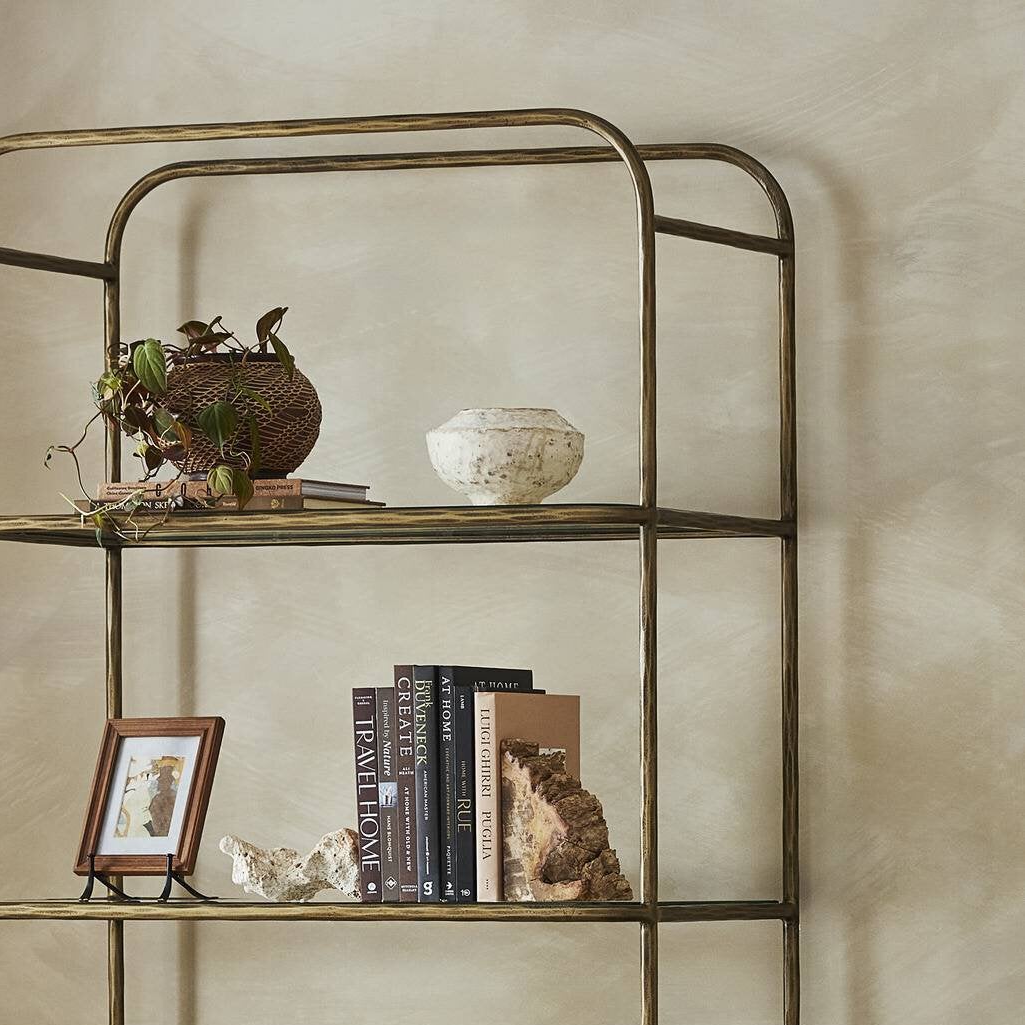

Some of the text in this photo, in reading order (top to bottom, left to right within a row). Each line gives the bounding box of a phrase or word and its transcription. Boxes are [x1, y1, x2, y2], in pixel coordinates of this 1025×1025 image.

[398, 677, 413, 757] CREATE
[415, 680, 427, 765] DUVENECK
[425, 680, 433, 708] Frank
[441, 676, 452, 741] AT HOME
[355, 715, 377, 795] TRAVEL
[382, 729, 389, 738] by
[383, 740, 392, 776] Nature
[404, 786, 410, 795] AT
[457, 799, 471, 833] RUE
[480, 709, 492, 860] LUIGI GHIRRI PUGLIA
[359, 801, 380, 872] HOME
